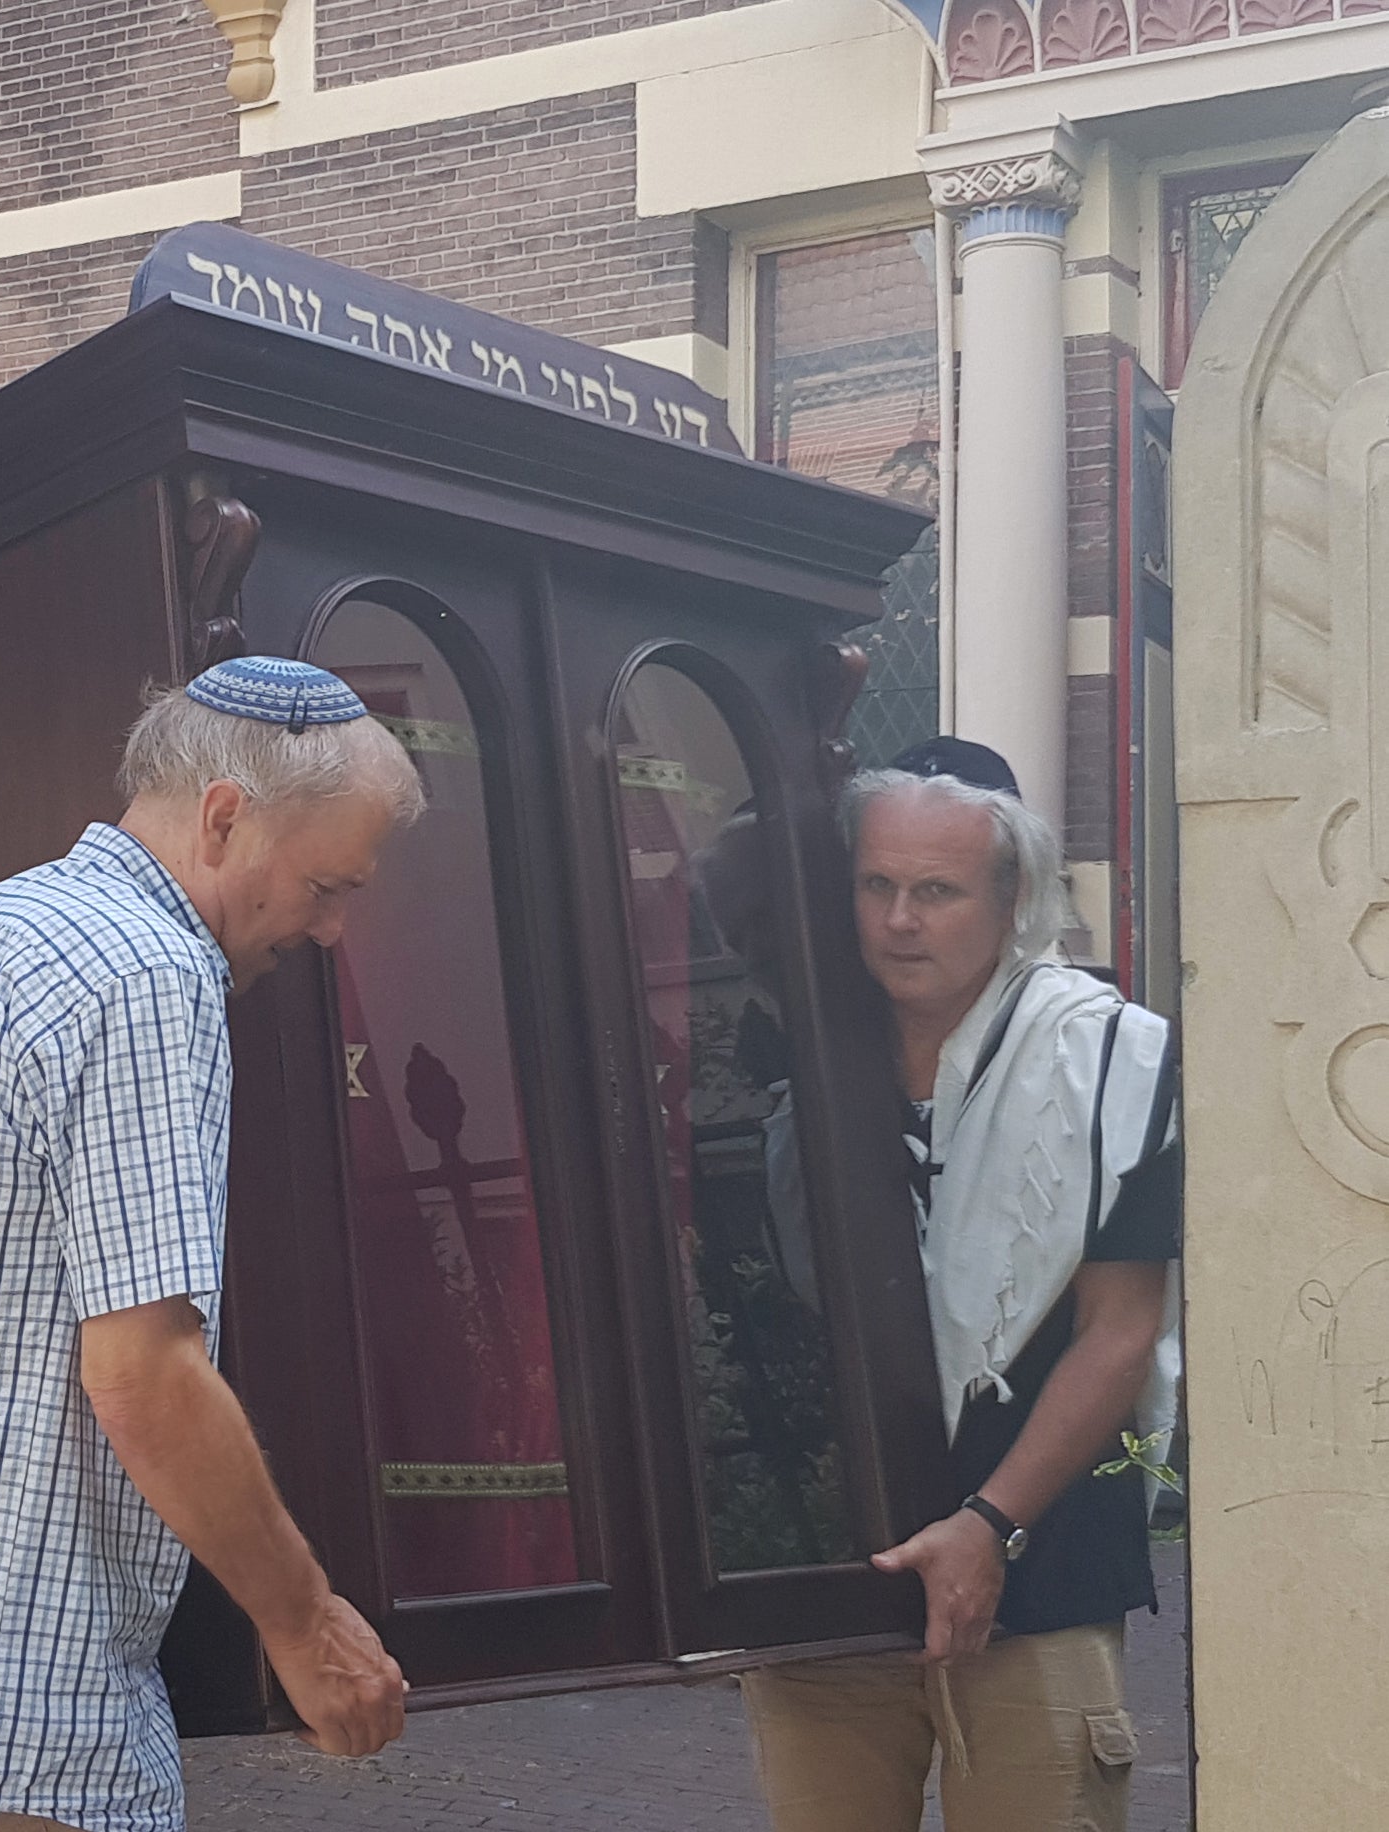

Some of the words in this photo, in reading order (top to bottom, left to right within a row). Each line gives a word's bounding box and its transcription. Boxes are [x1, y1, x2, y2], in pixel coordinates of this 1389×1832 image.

[187, 252, 322, 335] עומד
[345, 302, 452, 373] אתה
[471, 340, 527, 395] מי
[653, 397, 708, 448] דע
